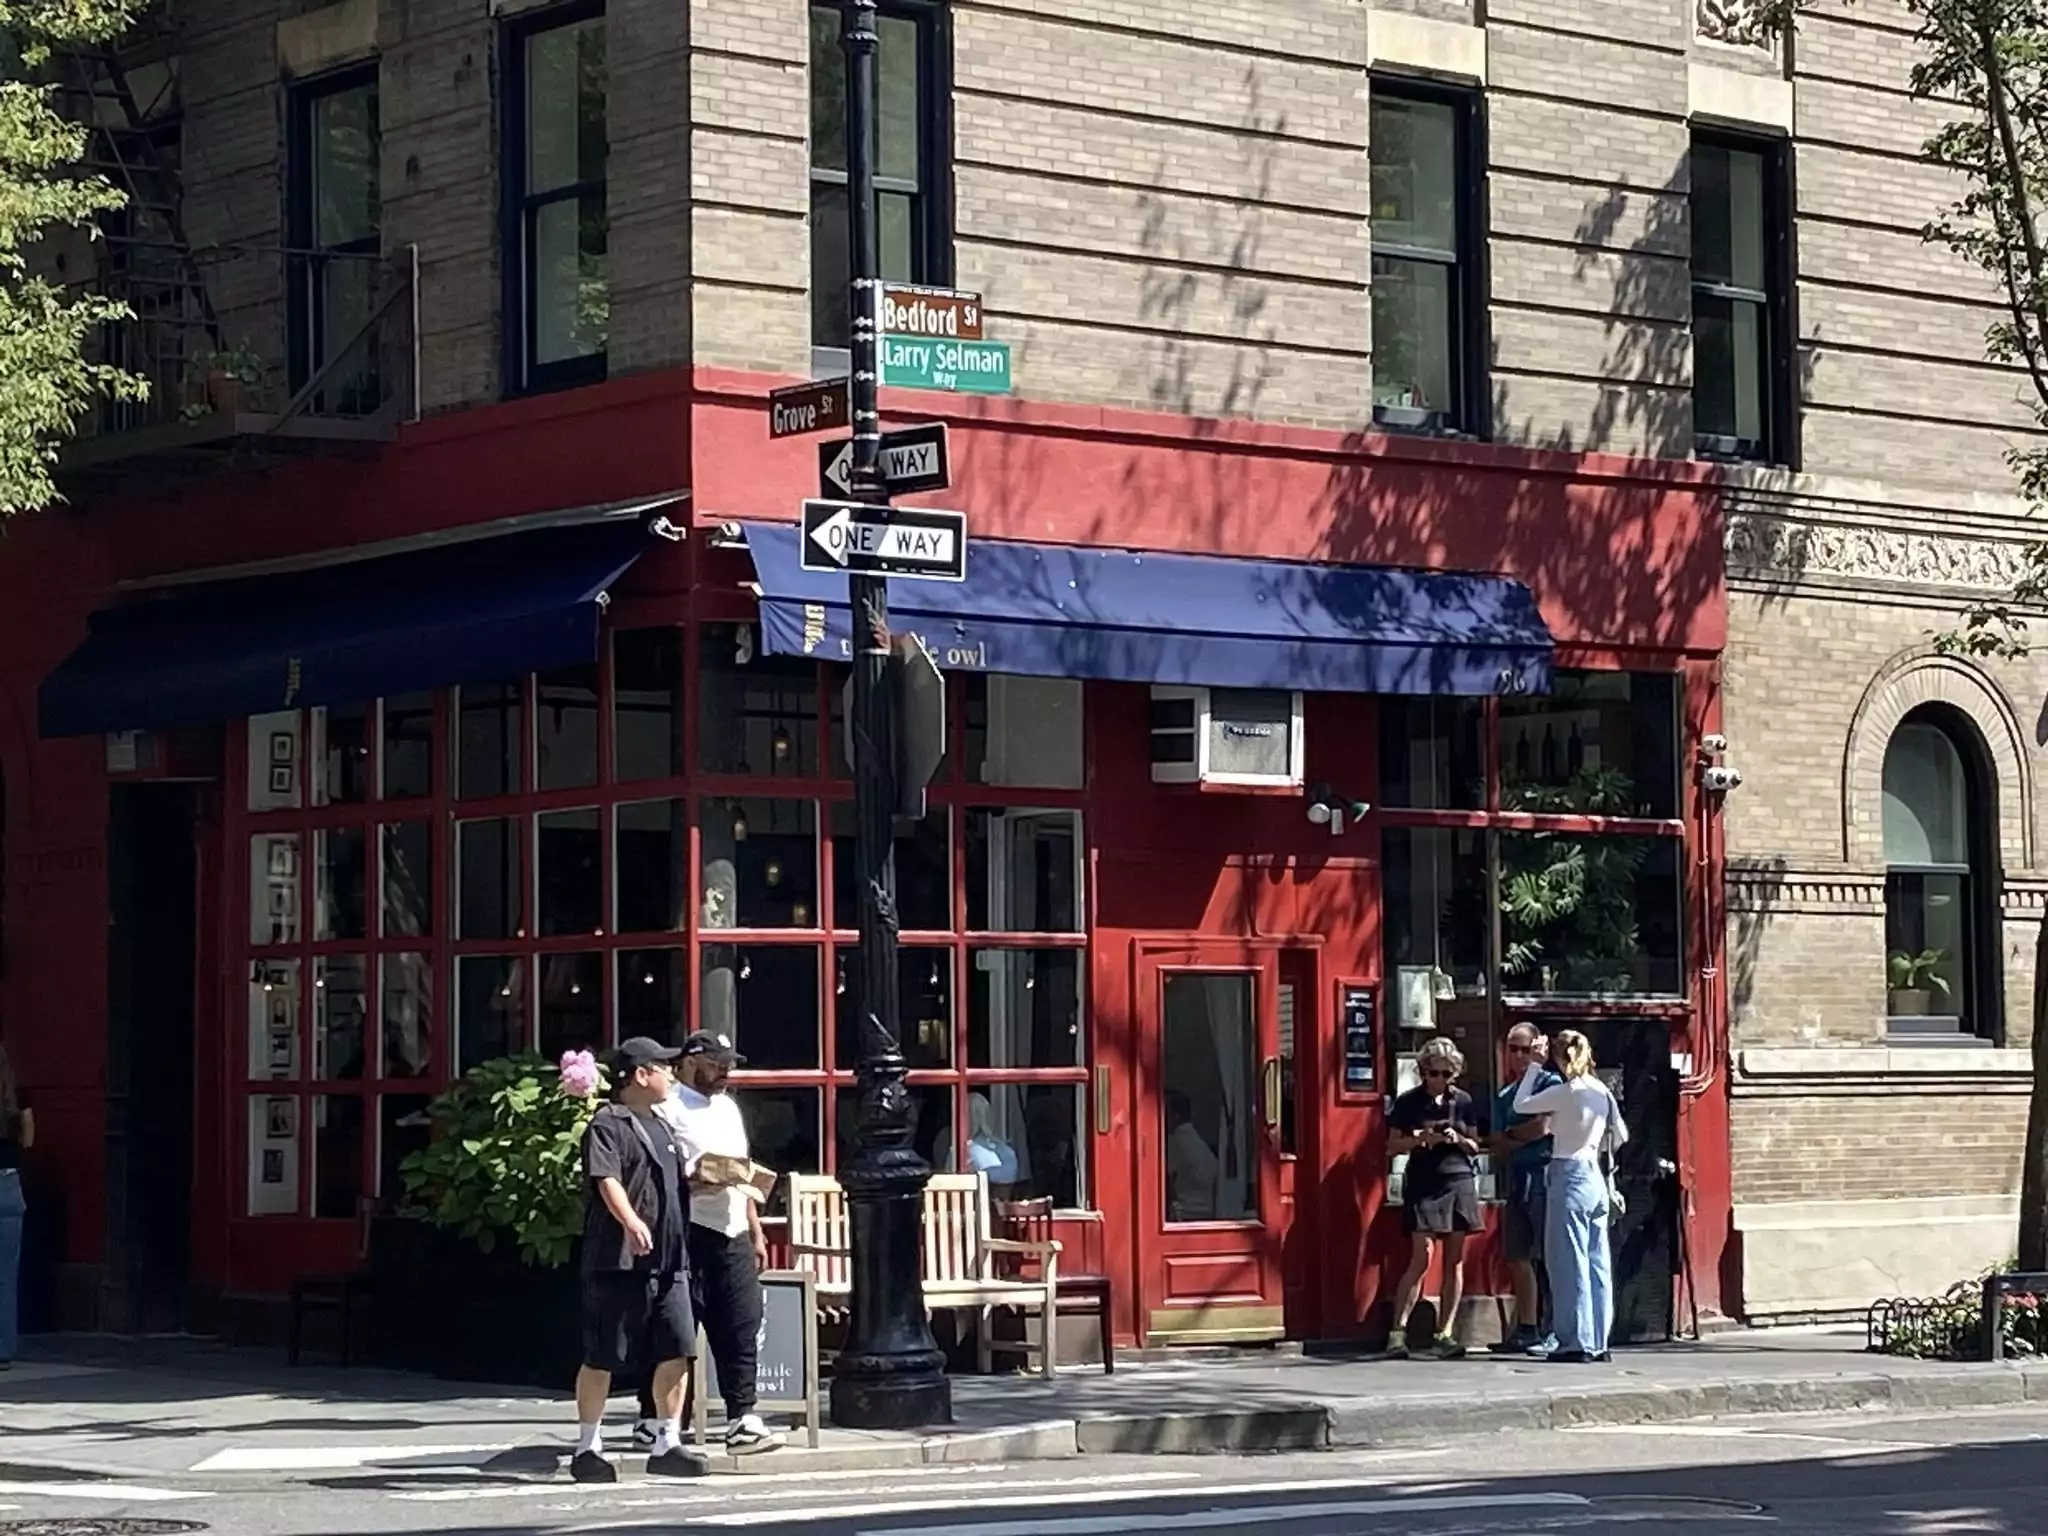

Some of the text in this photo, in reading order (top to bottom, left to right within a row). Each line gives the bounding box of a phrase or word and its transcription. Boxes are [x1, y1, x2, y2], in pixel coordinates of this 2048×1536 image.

[884, 297, 978, 336] Bedford St
[884, 340, 1004, 375] Larry Selman
[774, 394, 834, 434] Grove St
[890, 446, 929, 476] WAY
[829, 524, 943, 557] ONE WAY
[947, 641, 987, 668] owl
